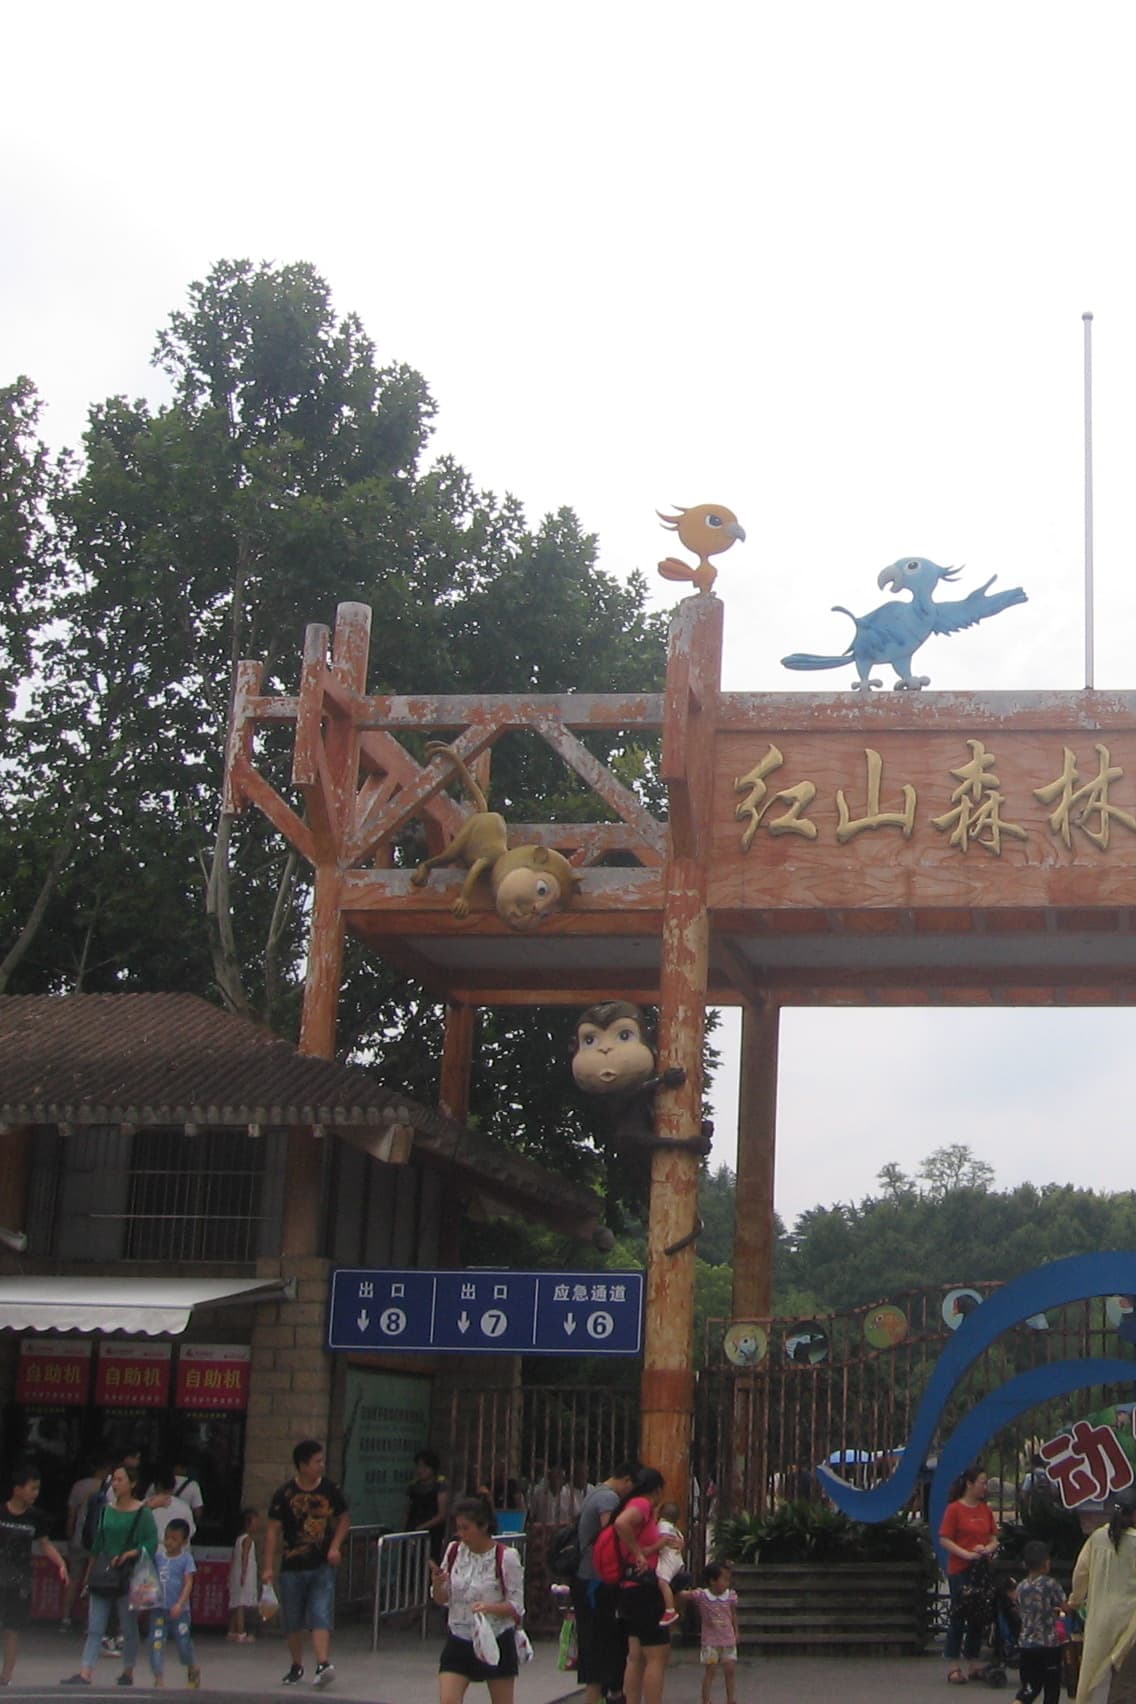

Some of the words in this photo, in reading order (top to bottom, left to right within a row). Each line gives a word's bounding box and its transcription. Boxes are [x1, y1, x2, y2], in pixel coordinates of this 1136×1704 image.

[358, 1280, 405, 1299] 出口
[460, 1282, 508, 1301] 出口
[553, 1284, 627, 1303] 应急通道
[384, 1310, 401, 1334] 8
[485, 1313, 502, 1336] 7
[591, 1313, 609, 1337] 6
[105, 1366, 161, 1388] 自助机
[185, 1368, 241, 1389] 自助机
